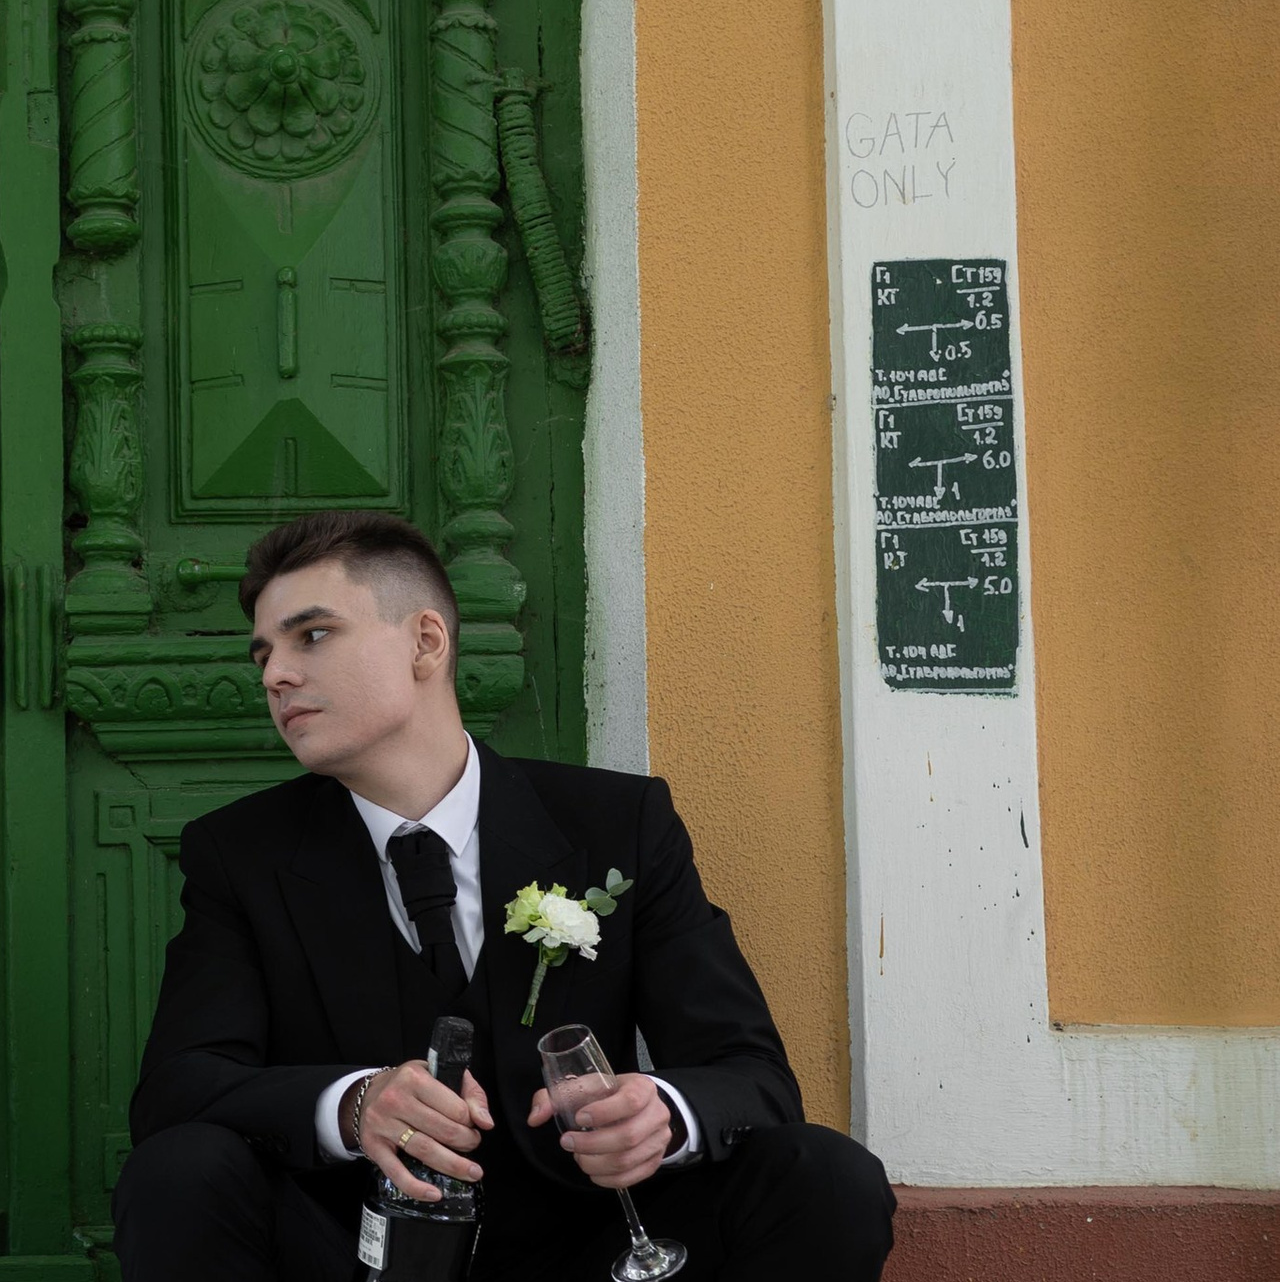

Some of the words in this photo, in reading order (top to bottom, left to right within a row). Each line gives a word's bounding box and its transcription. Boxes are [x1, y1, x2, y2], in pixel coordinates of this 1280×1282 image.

[846, 112, 954, 158] GATA
[851, 161, 956, 208] ONLY
[966, 292, 994, 308] 1.2
[945, 340, 972, 361] 0.5
[973, 427, 998, 445] 1.2
[982, 450, 1011, 469] 6.0
[951, 481, 960, 500] 1
[981, 552, 1007, 567] 1.2
[983, 576, 1012, 595] 5.0
[957, 614, 965, 632] 1
